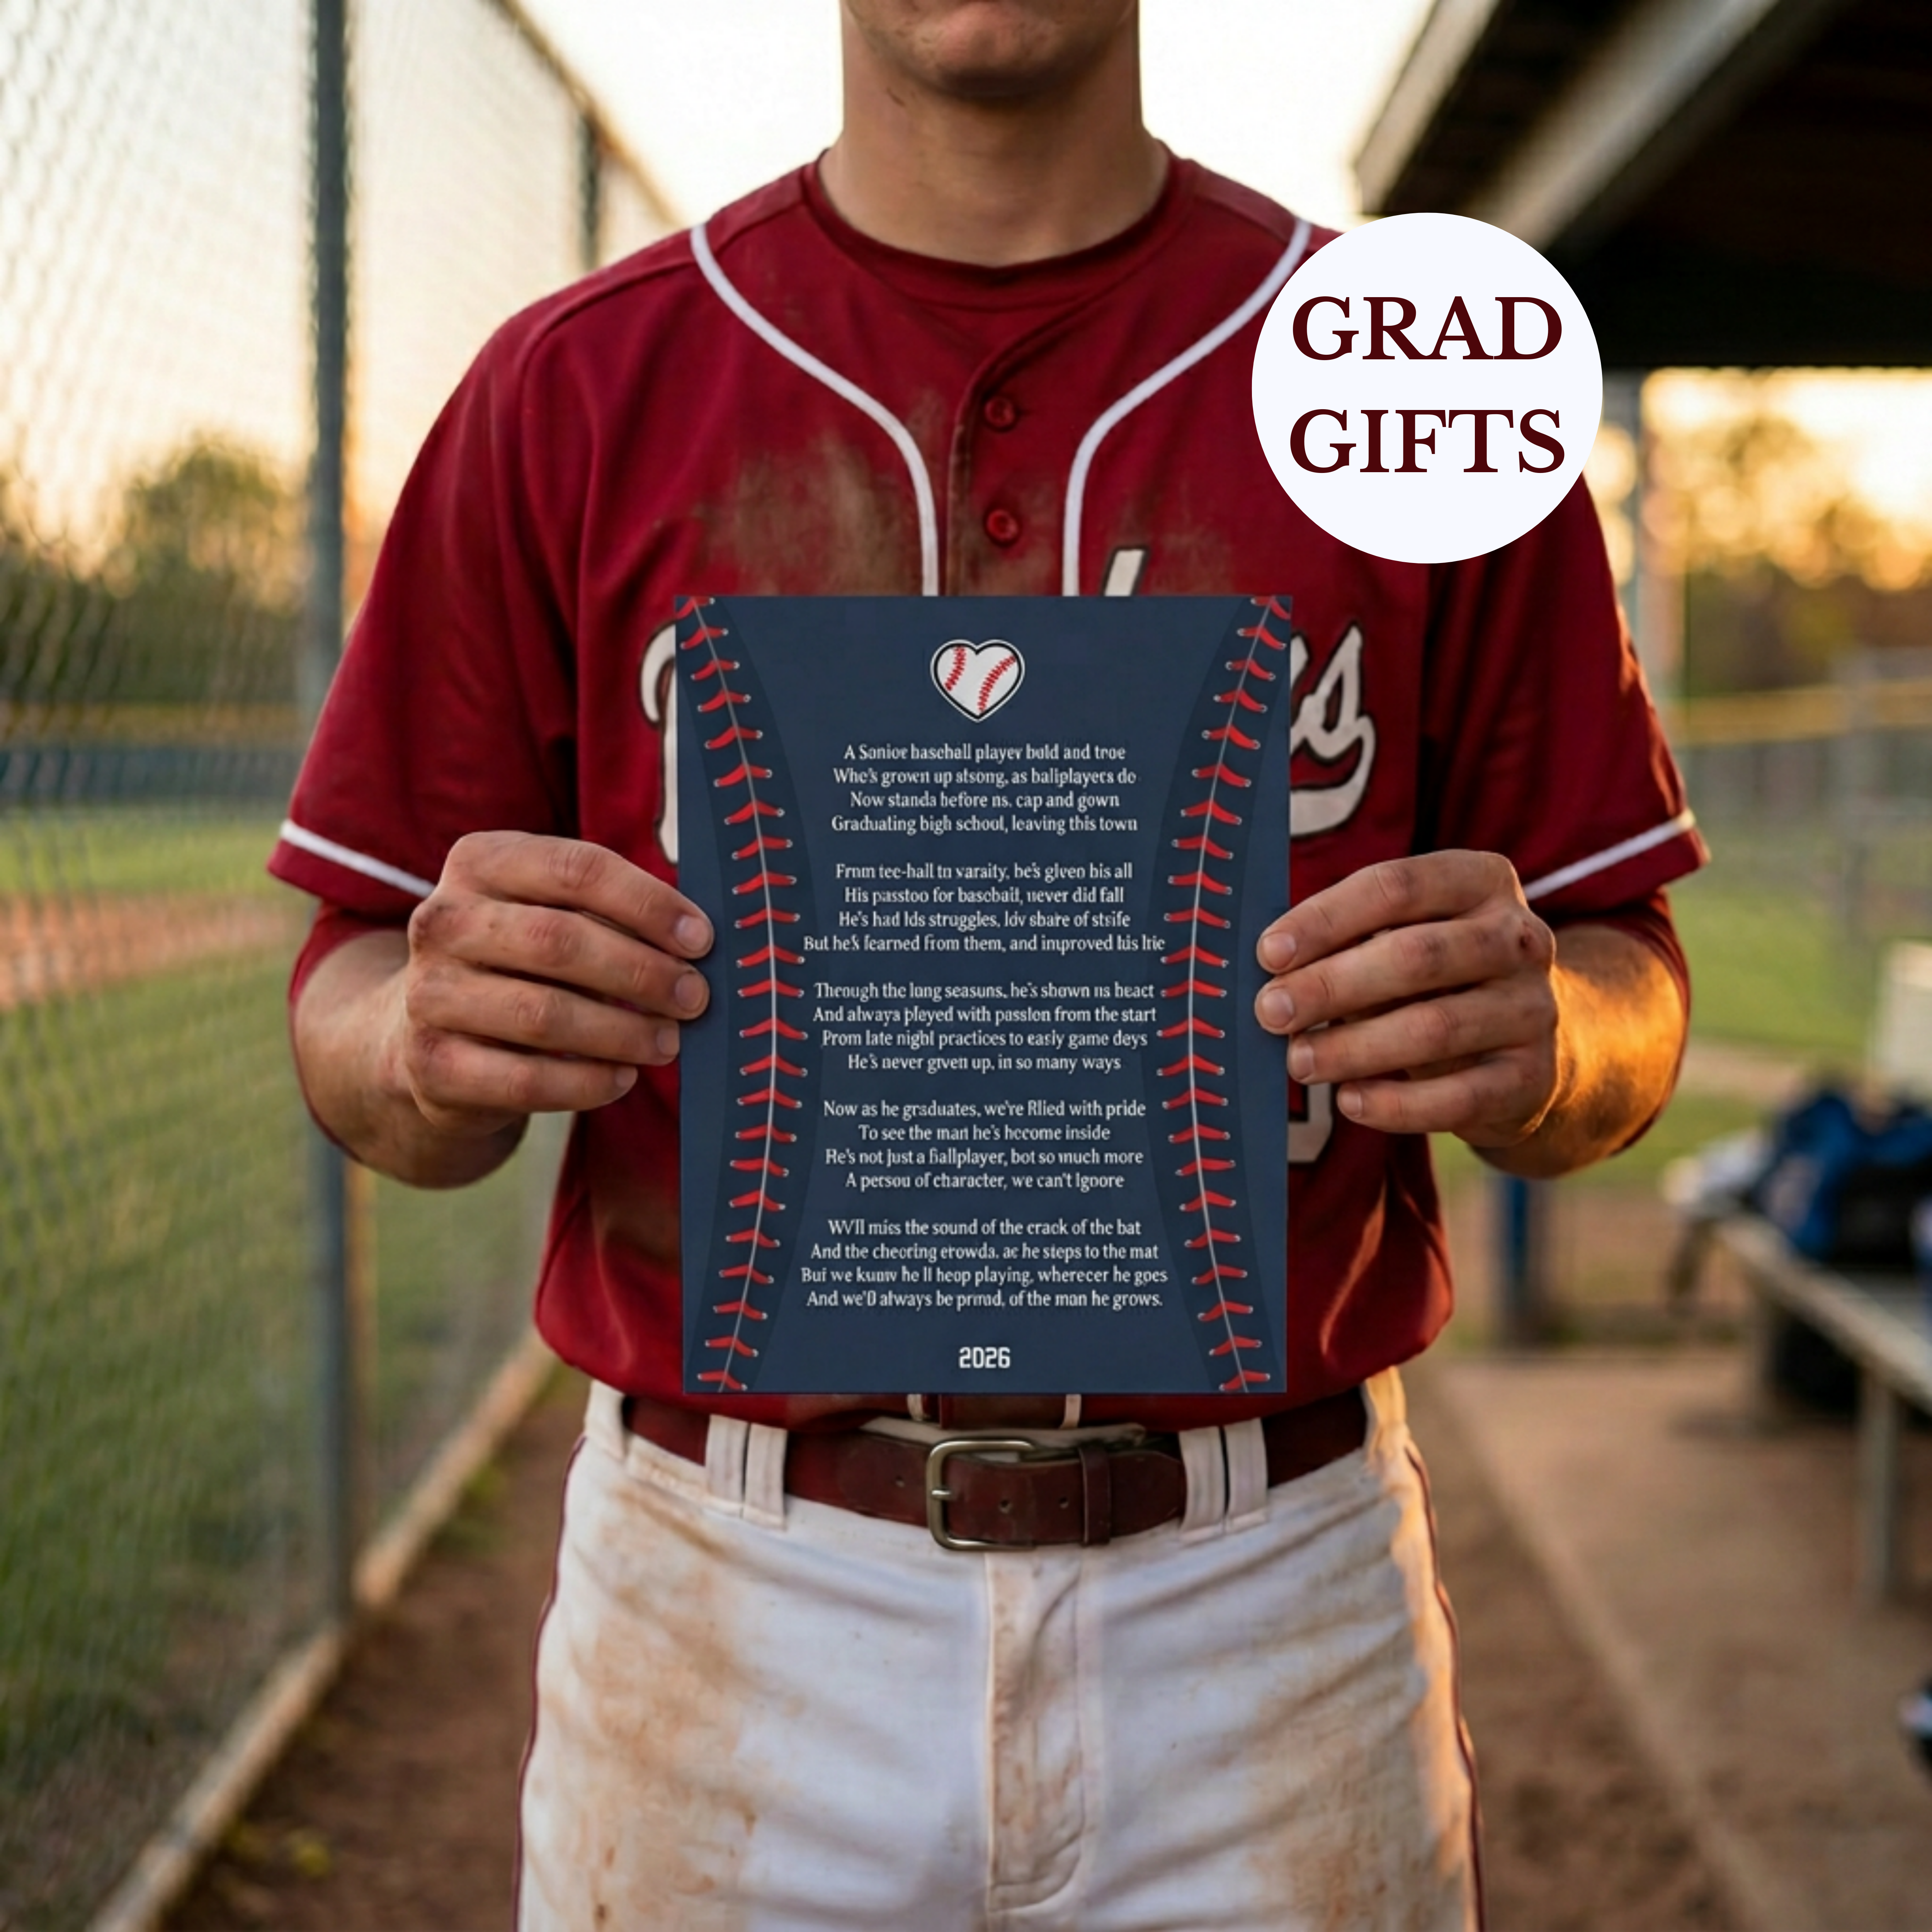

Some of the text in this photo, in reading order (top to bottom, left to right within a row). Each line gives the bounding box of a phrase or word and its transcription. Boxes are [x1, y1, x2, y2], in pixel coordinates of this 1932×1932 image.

[844, 745, 856, 760] A
[934, 771, 952, 788] up
[1011, 772, 1027, 784] as
[1117, 768, 1136, 784] do
[850, 791, 883, 807] Now
[1016, 796, 1043, 813] cap
[1045, 791, 1074, 808] and
[1077, 795, 1120, 813] gown
[1069, 815, 1097, 831] this
[1099, 817, 1138, 831] town
[1114, 862, 1133, 878] all
[845, 886, 869, 903] His
[933, 886, 954, 903] for
[1072, 886, 1097, 903] did
[1100, 886, 1124, 903] fall
[839, 910, 869, 927] He's
[1073, 910, 1090, 927] of
[1009, 934, 1037, 951] and
[813, 1005, 844, 1022] And
[957, 1005, 991, 1022] with
[1054, 1005, 1091, 1022] from
[1094, 1006, 1119, 1022] the
[1121, 1007, 1156, 1022] start
[866, 1029, 893, 1046] late
[1009, 1033, 1024, 1046] to
[1068, 1034, 1109, 1049] game
[848, 1054, 878, 1069] He's
[998, 1054, 1012, 1069] in
[1016, 1058, 1032, 1069] so
[1036, 1058, 1077, 1074] many
[1082, 1058, 1121, 1074] ways
[824, 1100, 857, 1116] Now
[861, 1104, 878, 1116] as
[881, 1100, 899, 1117] he
[1069, 1100, 1103, 1116] with
[858, 1124, 878, 1140] To
[909, 1124, 932, 1140] the
[859, 1151, 883, 1164] not
[916, 1152, 925, 1164] a
[1039, 1152, 1055, 1164] so
[1104, 1152, 1144, 1163] more
[847, 1172, 857, 1187] A
[915, 1172, 932, 1188] of
[1012, 1177, 1033, 1188] we
[905, 1219, 929, 1235] the
[932, 1218, 978, 1235] sound
[981, 1219, 997, 1235] of
[1000, 1218, 1024, 1235] the
[1071, 1218, 1088, 1235] of
[1117, 1218, 1141, 1235] bat
[811, 1242, 841, 1259] And
[1022, 1242, 1040, 1259] he
[1085, 1245, 1099, 1259] to
[1102, 1243, 1126, 1259] the
[1130, 1245, 1158, 1259] mat
[830, 1271, 853, 1282] we
[901, 1265, 920, 1282] he
[1113, 1265, 1131, 1282] he
[807, 1290, 838, 1306] And
[936, 1290, 954, 1306] be
[1009, 1289, 1026, 1306] of
[1027, 1289, 1051, 1306] the
[1092, 1289, 1110, 1306] he
[959, 1346, 1011, 1369] 2026
